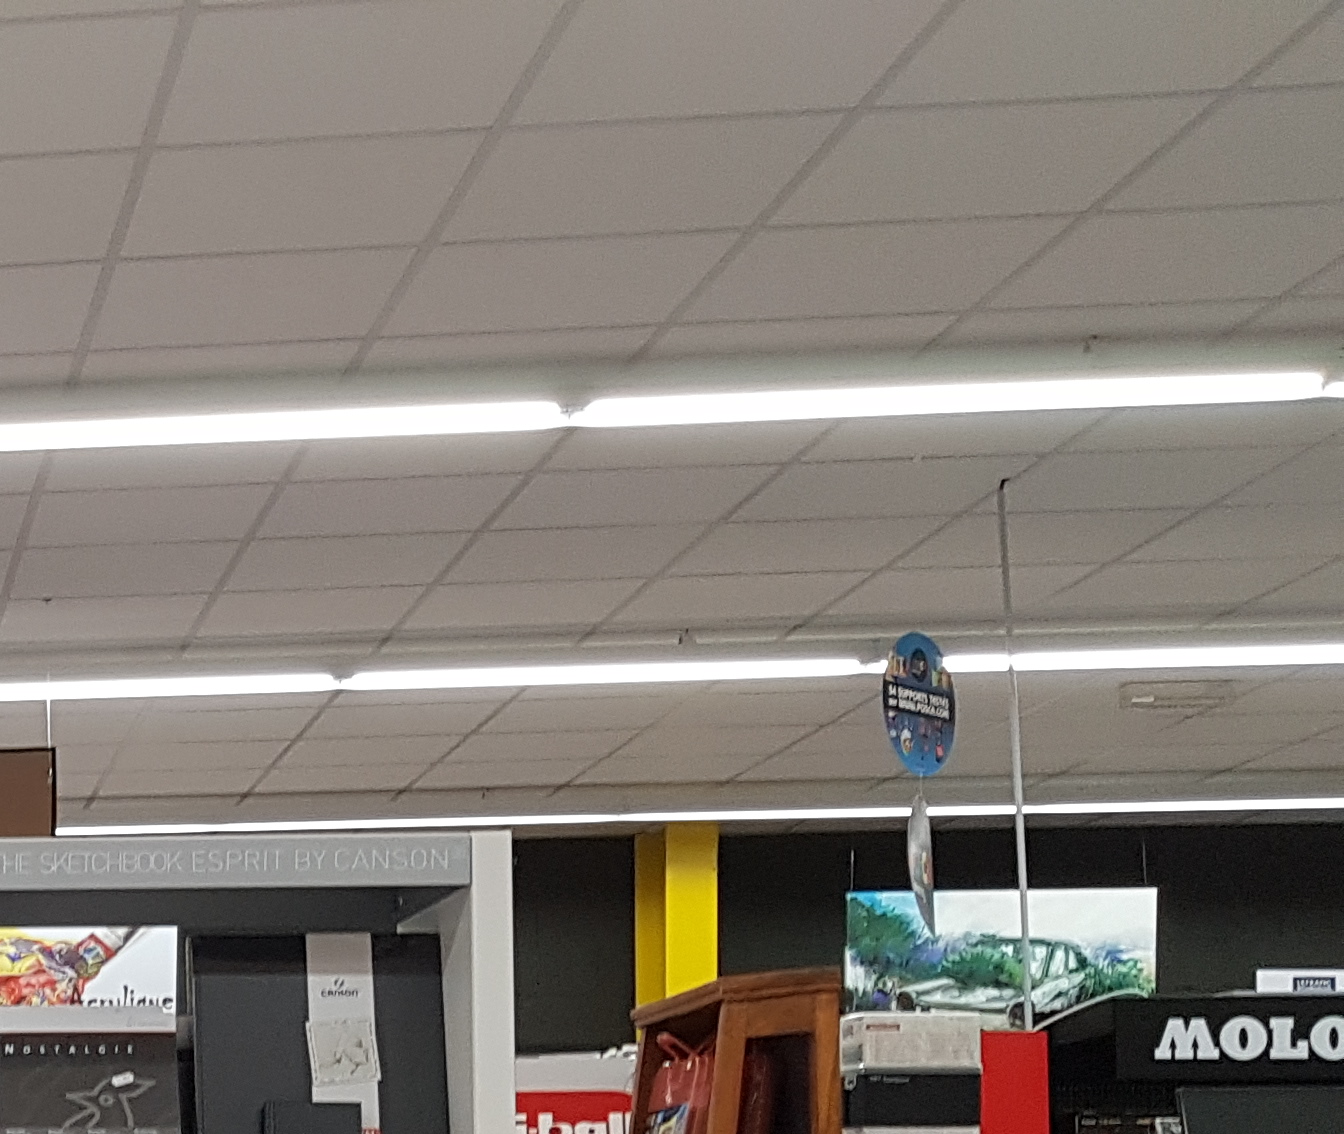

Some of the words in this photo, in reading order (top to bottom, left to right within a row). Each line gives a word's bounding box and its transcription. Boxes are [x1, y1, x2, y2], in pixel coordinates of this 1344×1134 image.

[39, 851, 183, 874] SKETCHBOOK
[192, 850, 280, 873] ESPRIT
[294, 849, 326, 872] BY
[333, 847, 450, 872] CANSON
[4, 1043, 134, 1056] NOSTALGIE
[1154, 1014, 1344, 1062] MOLO
